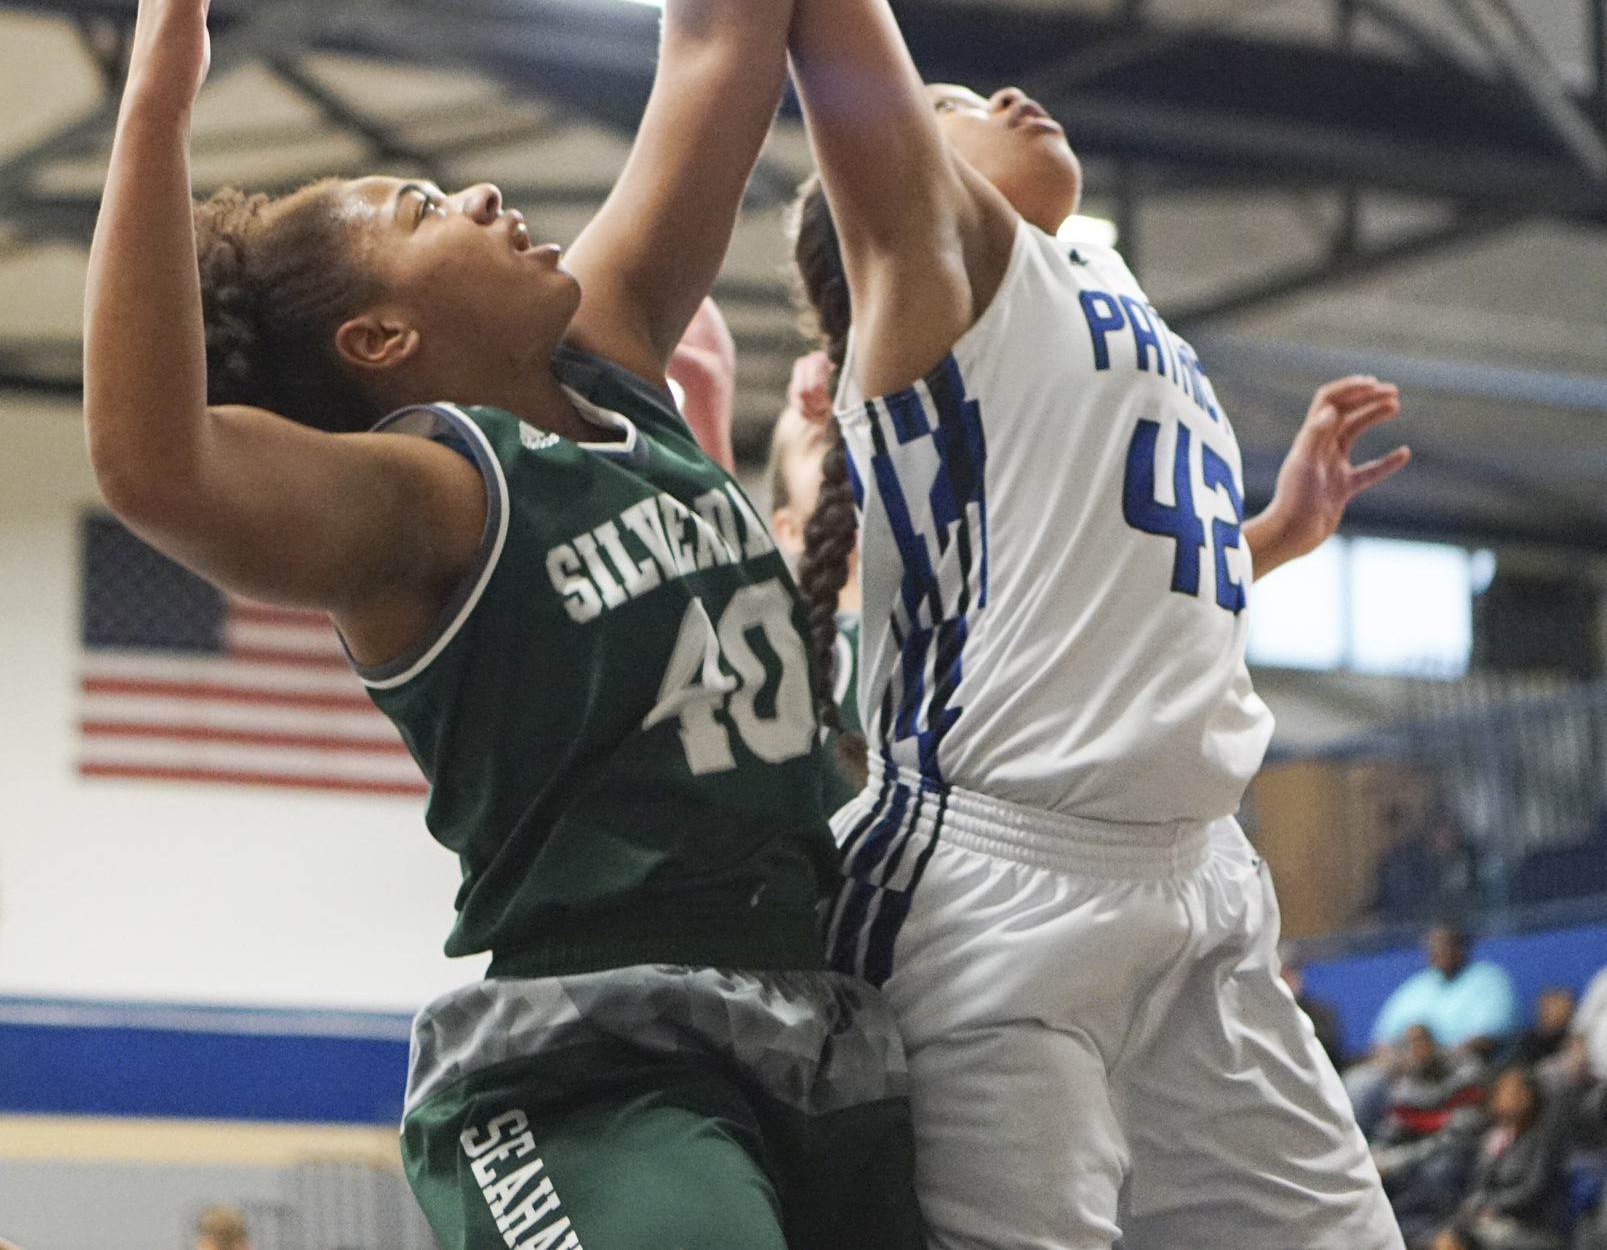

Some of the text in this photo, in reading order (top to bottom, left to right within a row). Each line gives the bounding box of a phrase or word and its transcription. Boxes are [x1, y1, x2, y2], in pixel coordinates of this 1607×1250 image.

[1122, 417, 1247, 615] 42
[641, 576, 818, 776] 40
[459, 1108, 585, 1250] SEAHA
